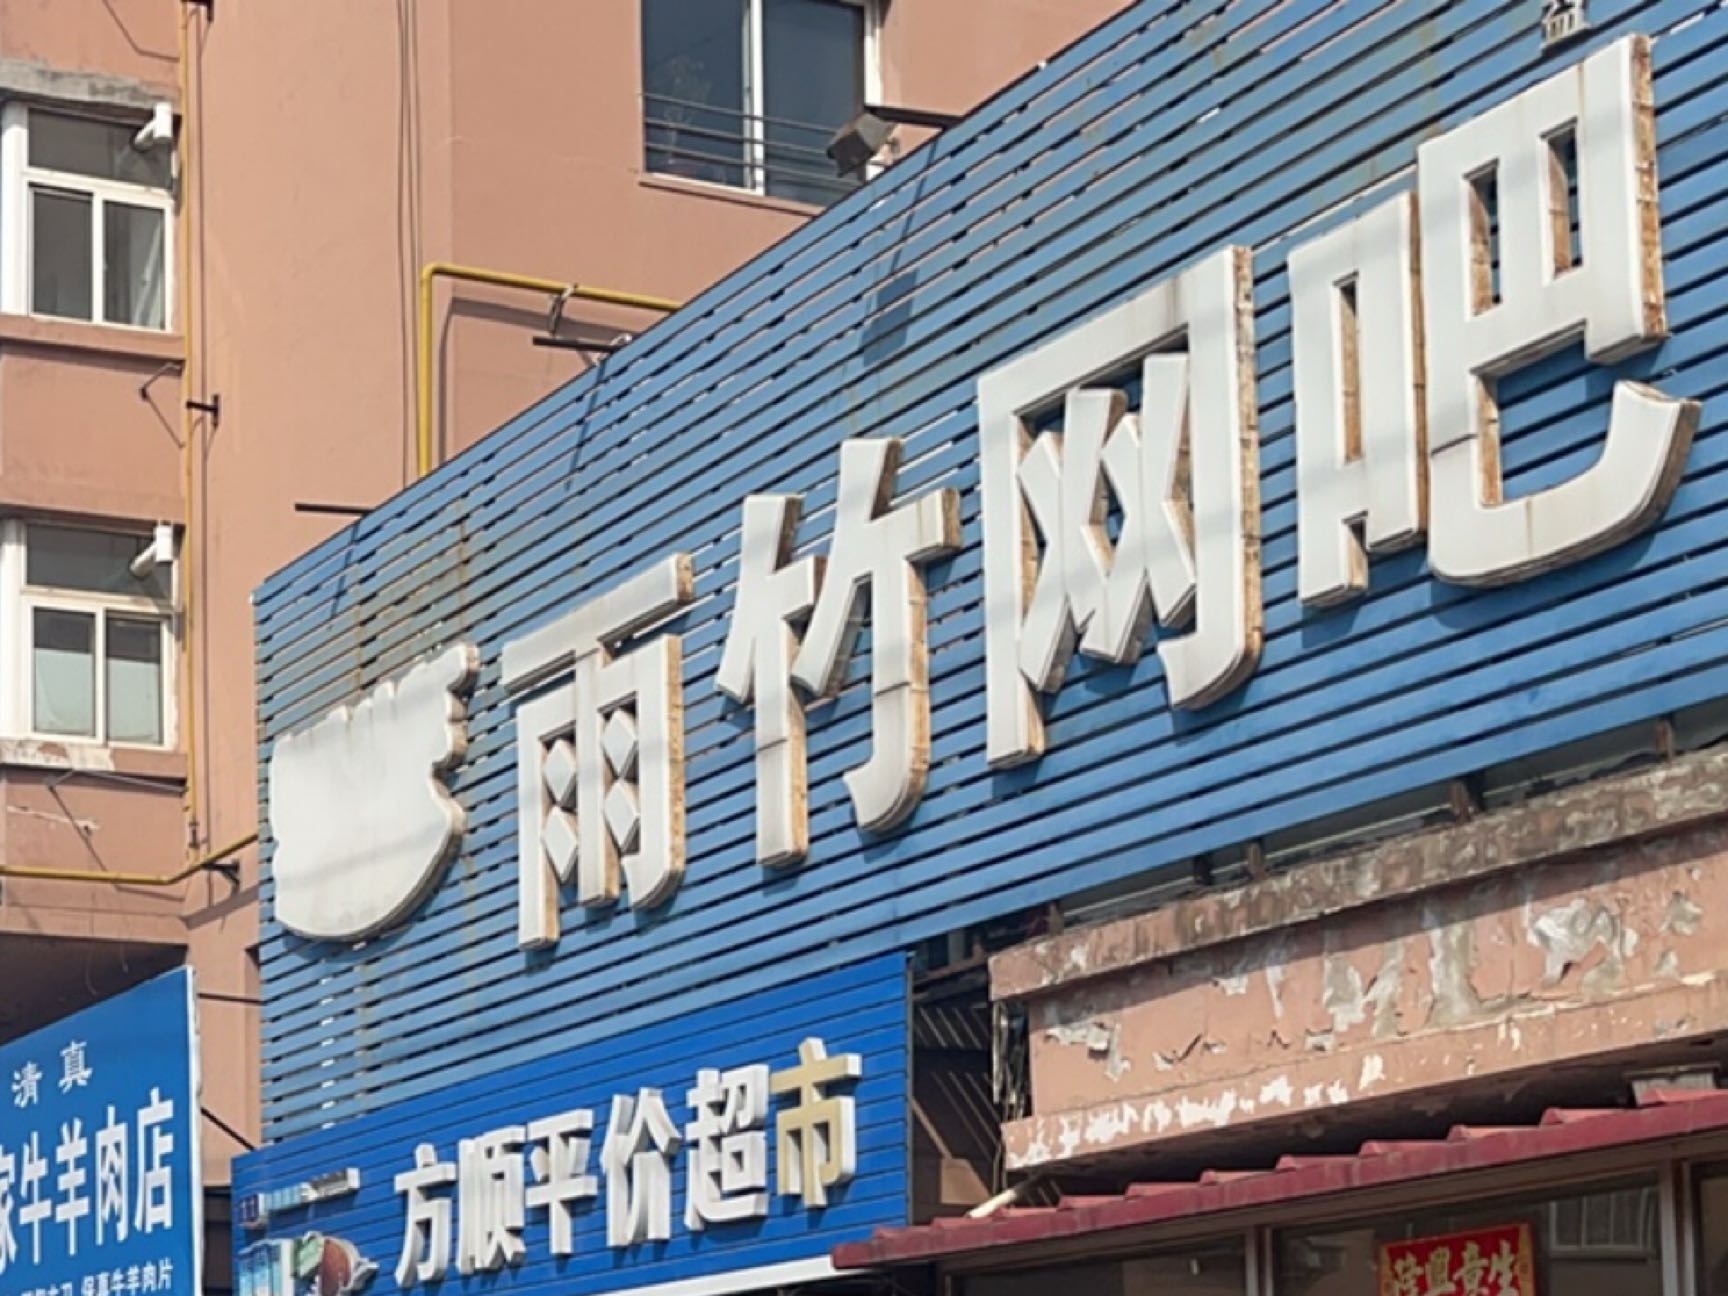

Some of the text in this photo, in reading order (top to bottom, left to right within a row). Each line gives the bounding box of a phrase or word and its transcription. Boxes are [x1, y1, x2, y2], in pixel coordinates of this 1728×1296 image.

[500, 31, 1701, 950] 雨竹网吧
[11, 1039, 93, 1108] 清真
[394, 1037, 862, 1287] 方顺平价超市
